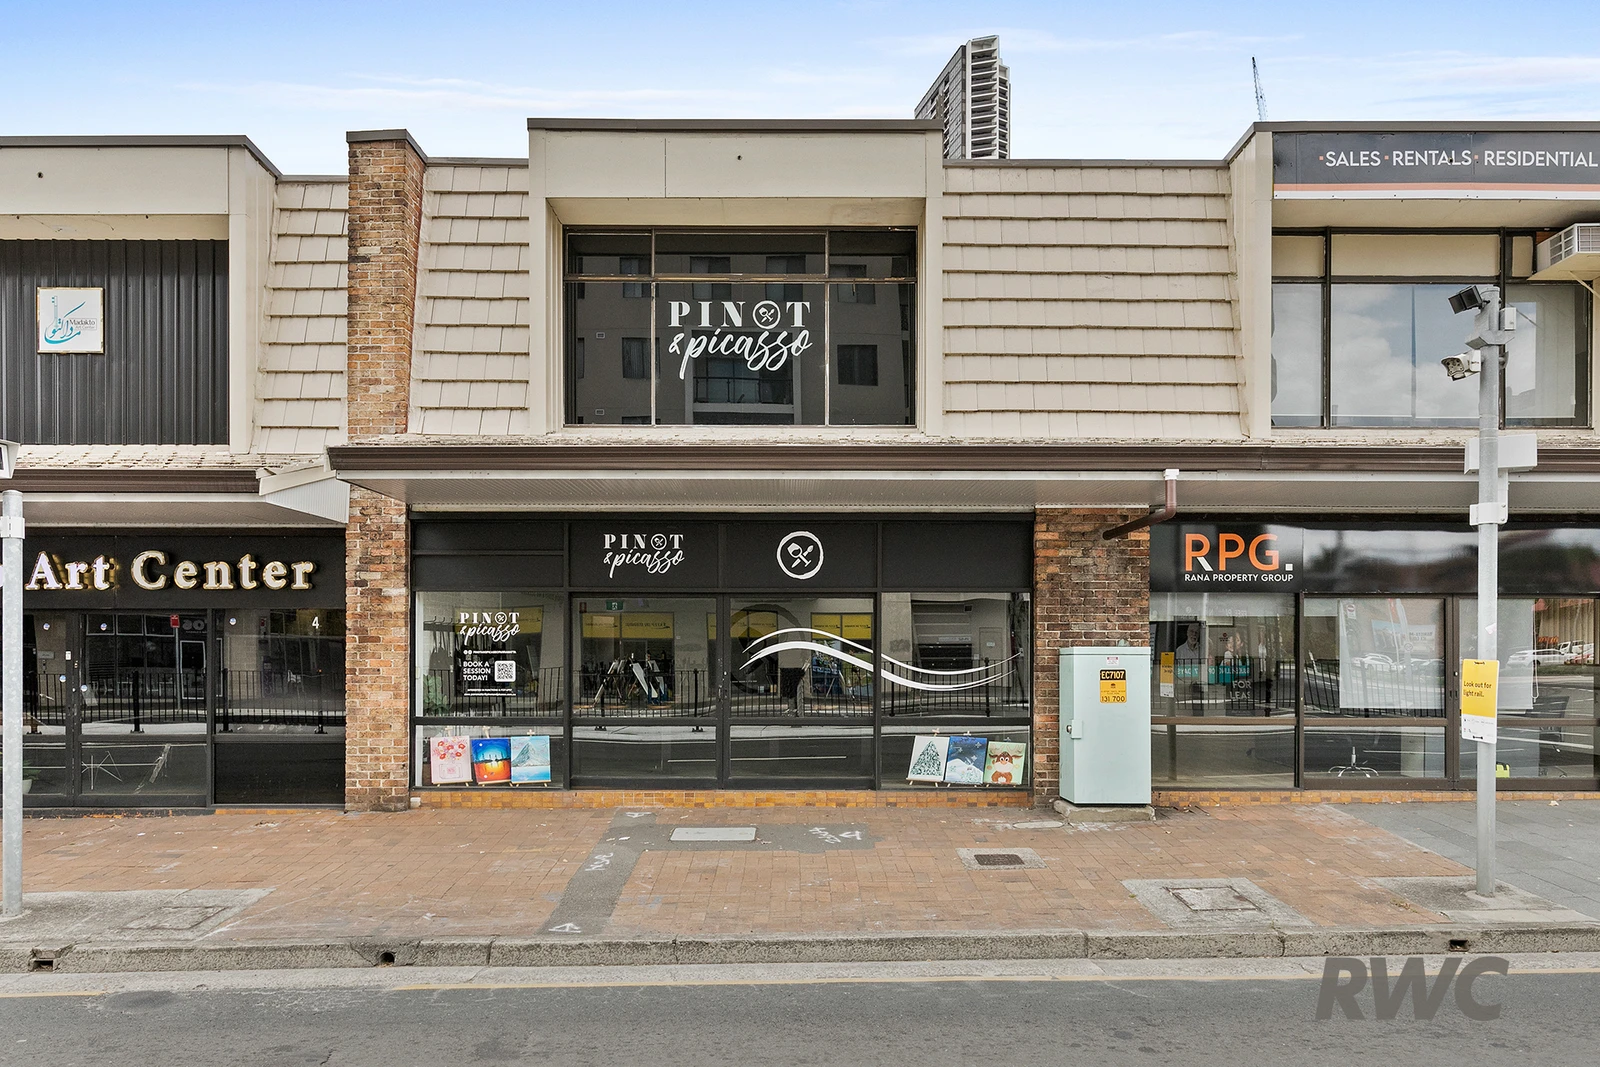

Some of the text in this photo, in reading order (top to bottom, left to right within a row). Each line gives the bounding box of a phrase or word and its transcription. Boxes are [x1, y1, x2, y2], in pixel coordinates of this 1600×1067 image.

[1325, 150, 1599, 168] SALES RENTALS RESIDENTIAL
[668, 299, 811, 330] PINOT
[603, 533, 684, 550] PINOT
[24, 550, 111, 591] Art
[130, 549, 317, 591] Center
[1184, 573, 1294, 582] RANA PROPERTY GROUP
[311, 616, 320, 629] 4
[459, 611, 520, 625] PINOT
[1101, 670, 1125, 680] EC7107
[1463, 680, 1474, 688] Look
